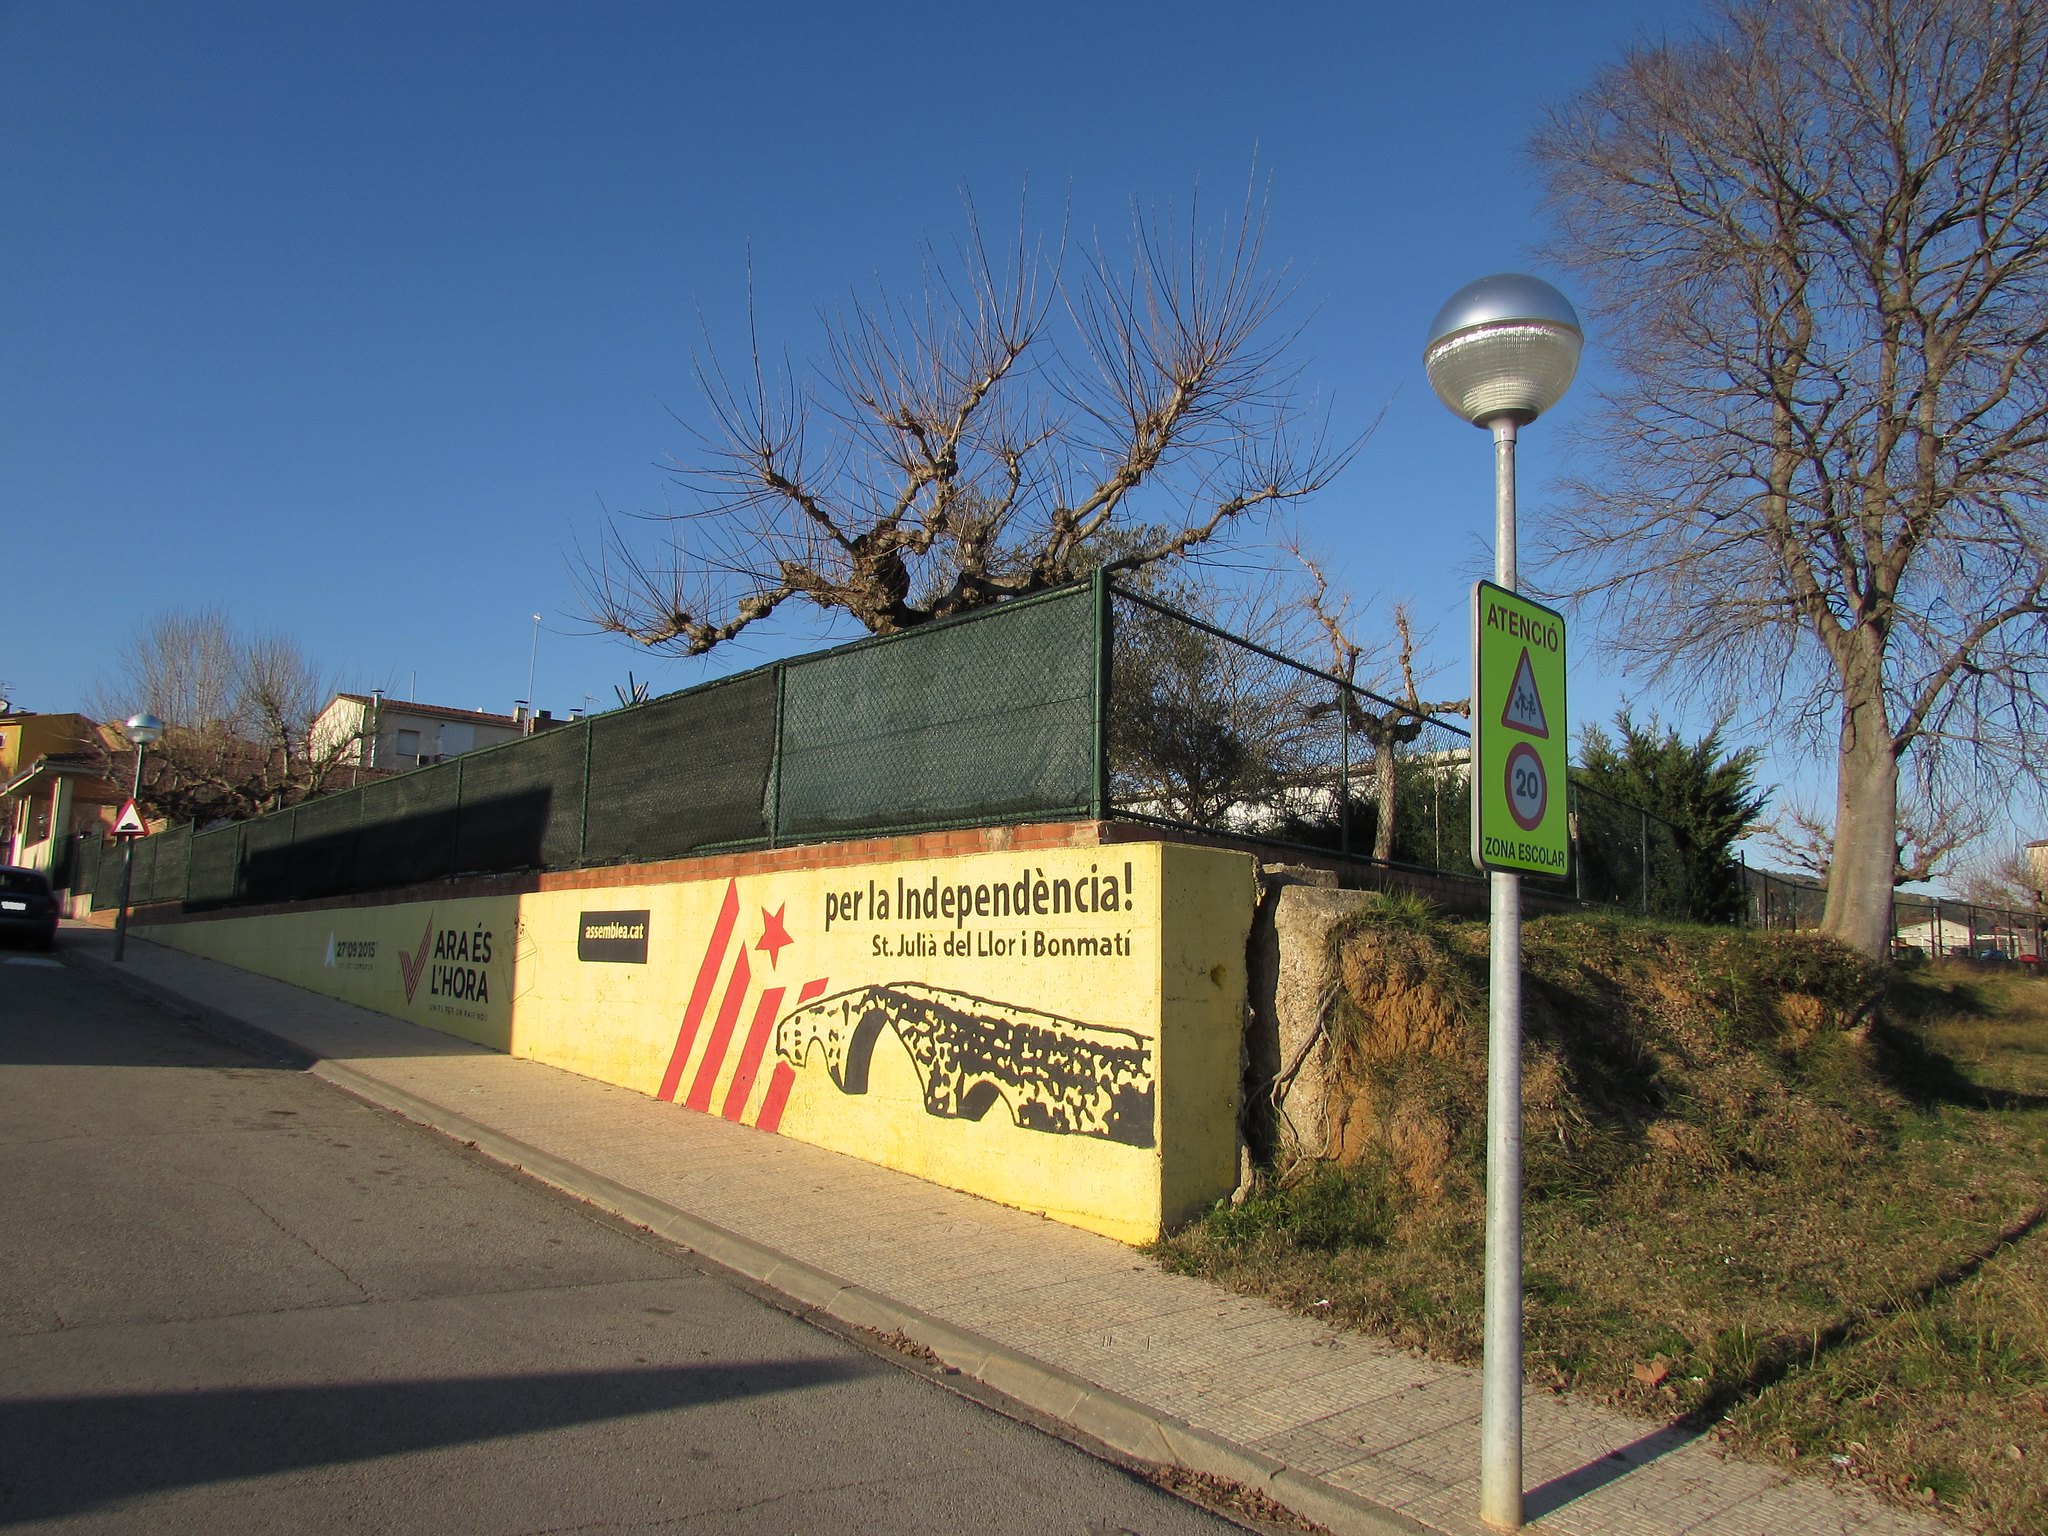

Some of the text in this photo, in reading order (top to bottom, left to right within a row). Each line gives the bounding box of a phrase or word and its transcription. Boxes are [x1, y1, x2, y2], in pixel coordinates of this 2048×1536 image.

[1486, 602, 1559, 652] ATENCIÓ
[1515, 768, 1539, 800] 20
[1485, 836, 1565, 868] ZONA ESCOLAR
[825, 861, 1133, 932] per la Independència!
[433, 921, 493, 963] ARA ÉS
[584, 921, 645, 939] assemblea.cat
[872, 929, 1133, 957] St. Julià del Llor i Bonmatí
[431, 964, 489, 1004] L'HORA
